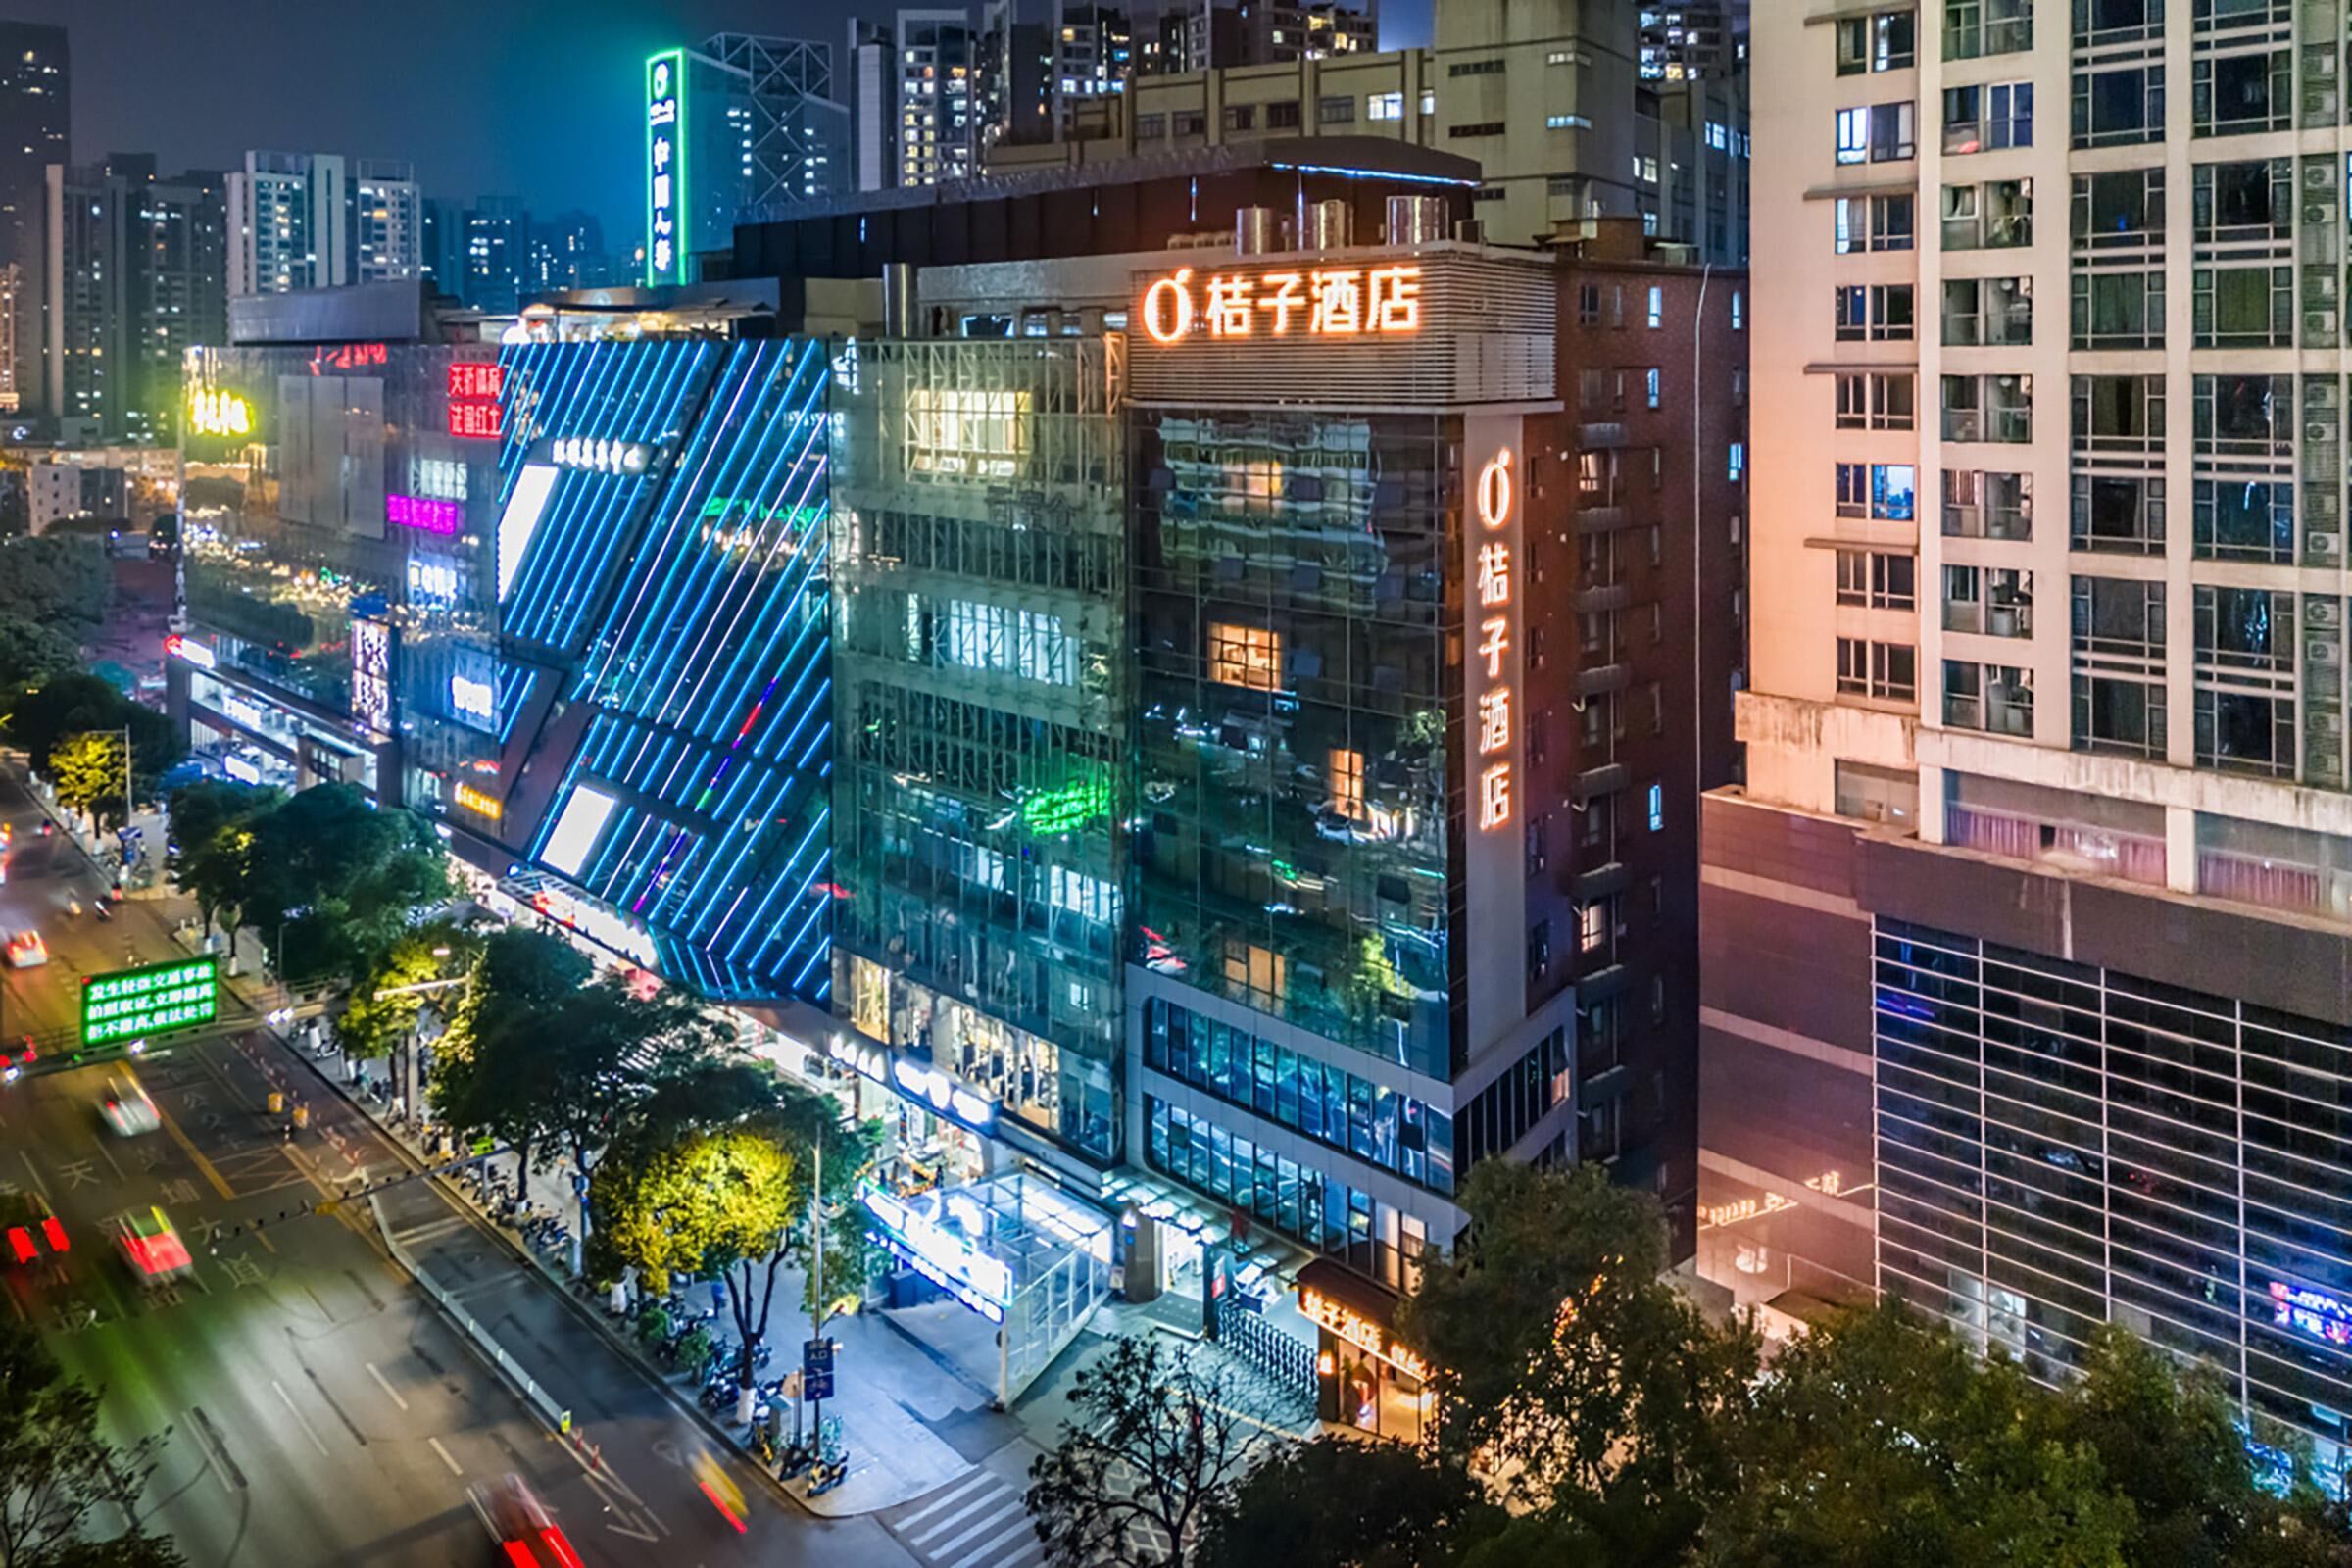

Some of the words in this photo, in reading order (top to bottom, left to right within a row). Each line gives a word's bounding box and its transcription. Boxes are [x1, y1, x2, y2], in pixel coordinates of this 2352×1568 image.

[1205, 266, 1422, 335] 桔子酒店
[1477, 541, 1512, 832] 桔子酒店
